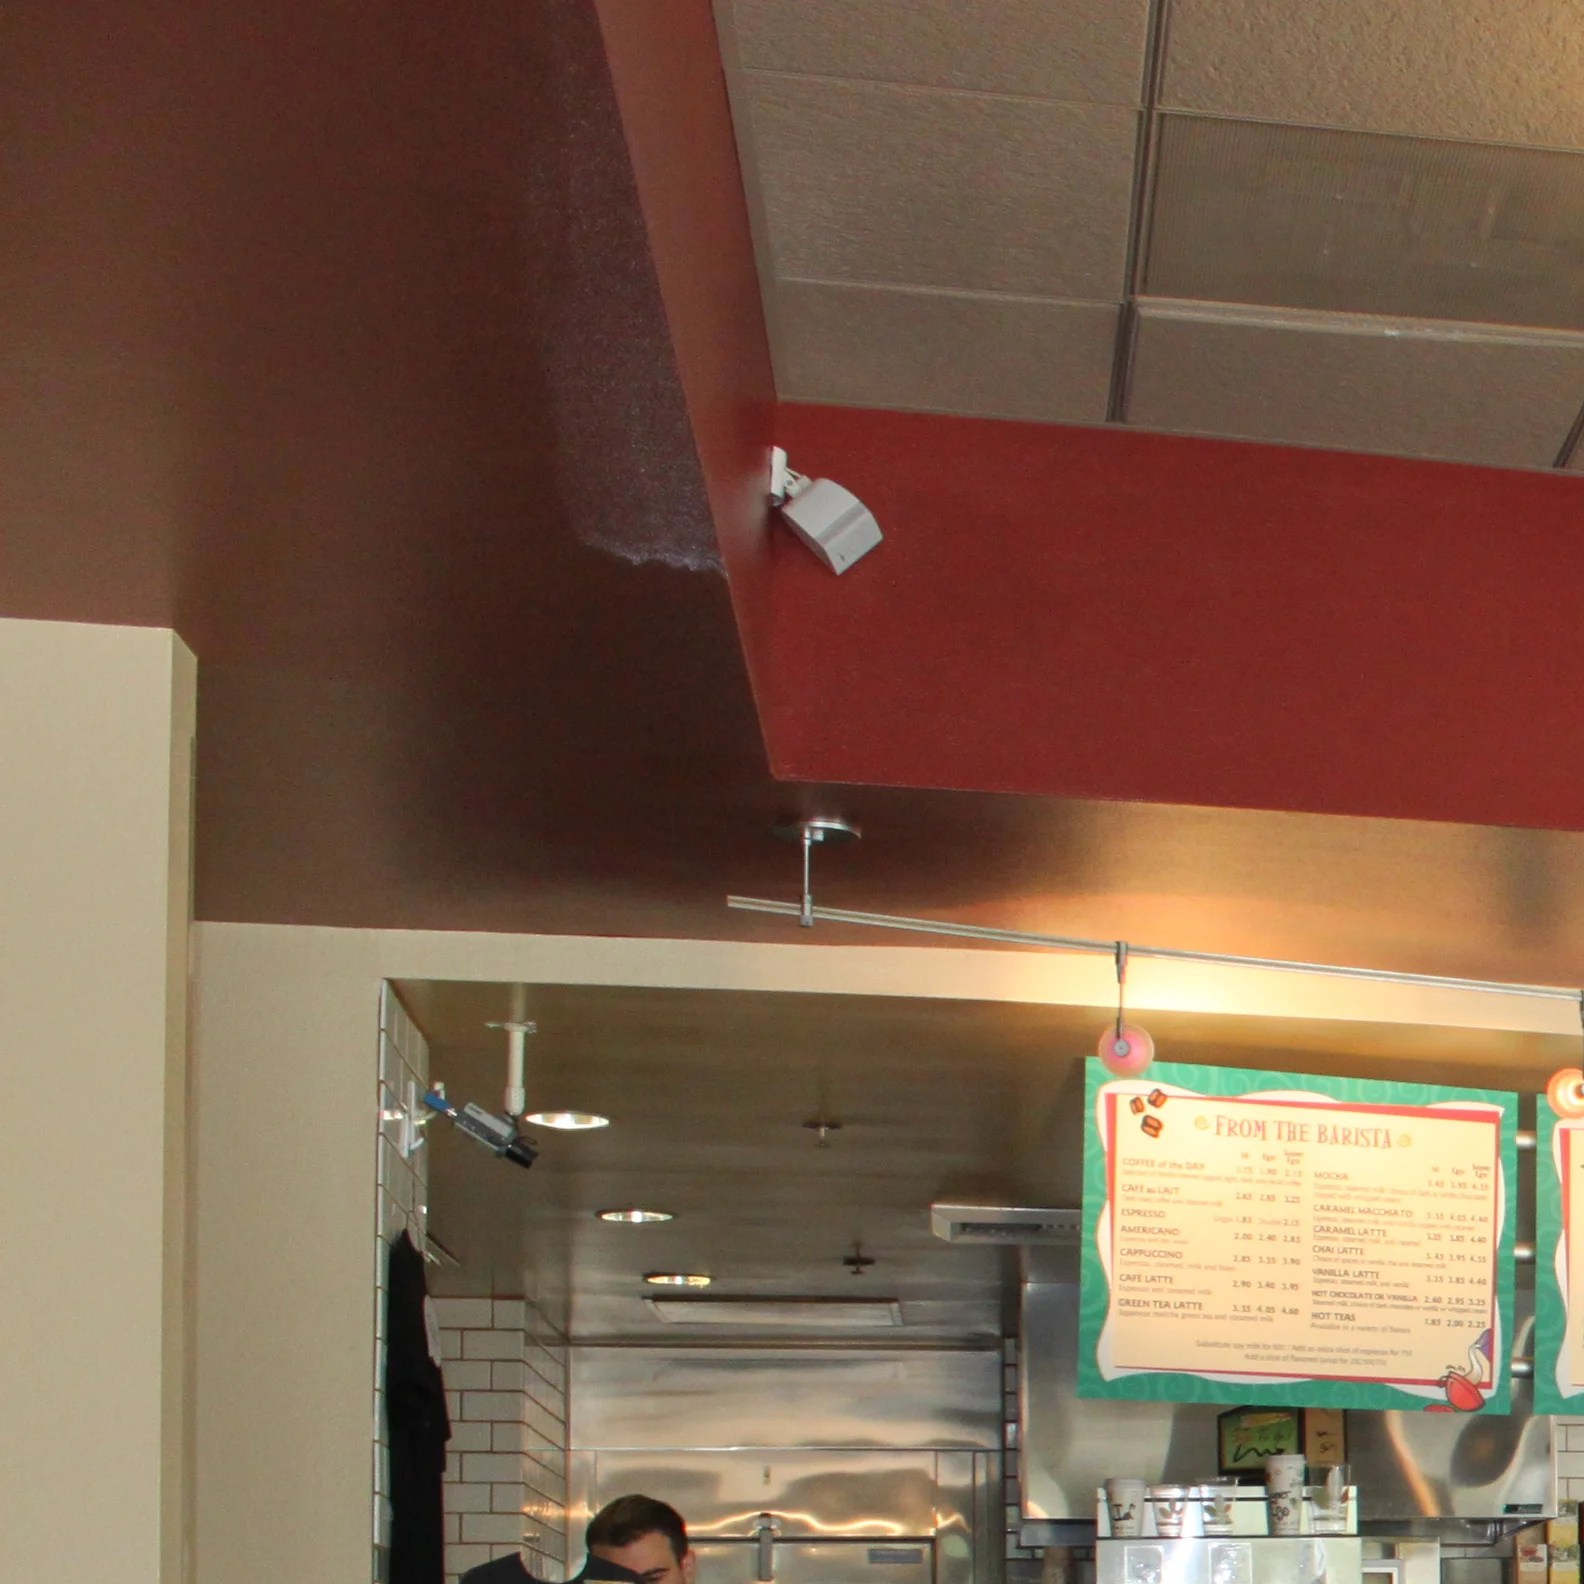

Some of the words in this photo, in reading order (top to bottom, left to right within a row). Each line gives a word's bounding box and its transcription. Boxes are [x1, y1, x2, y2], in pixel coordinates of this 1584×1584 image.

[1216, 1115, 1266, 1140] FROM
[1274, 1120, 1309, 1143] THE
[1317, 1123, 1391, 1148] BARISTA
[1122, 1209, 1165, 1218] ESPRESSO
[1313, 1204, 1355, 1214] CARAMEL
[1121, 1225, 1179, 1235] AMERICANO
[1313, 1225, 1356, 1235] CARAMEL
[1359, 1227, 1386, 1237] LATTE
[1120, 1248, 1183, 1258] CAPPUCCINO
[1338, 1246, 1364, 1255] LATTE
[1312, 1268, 1349, 1277] VANILLA
[1353, 1270, 1380, 1279] LATTE
[1119, 1299, 1150, 1307] GREEN
[1153, 1300, 1171, 1308] TEA
[1174, 1301, 1203, 1310] LATTE
[1312, 1312, 1330, 1320] HOT
[1334, 1313, 1356, 1321] TEAS
